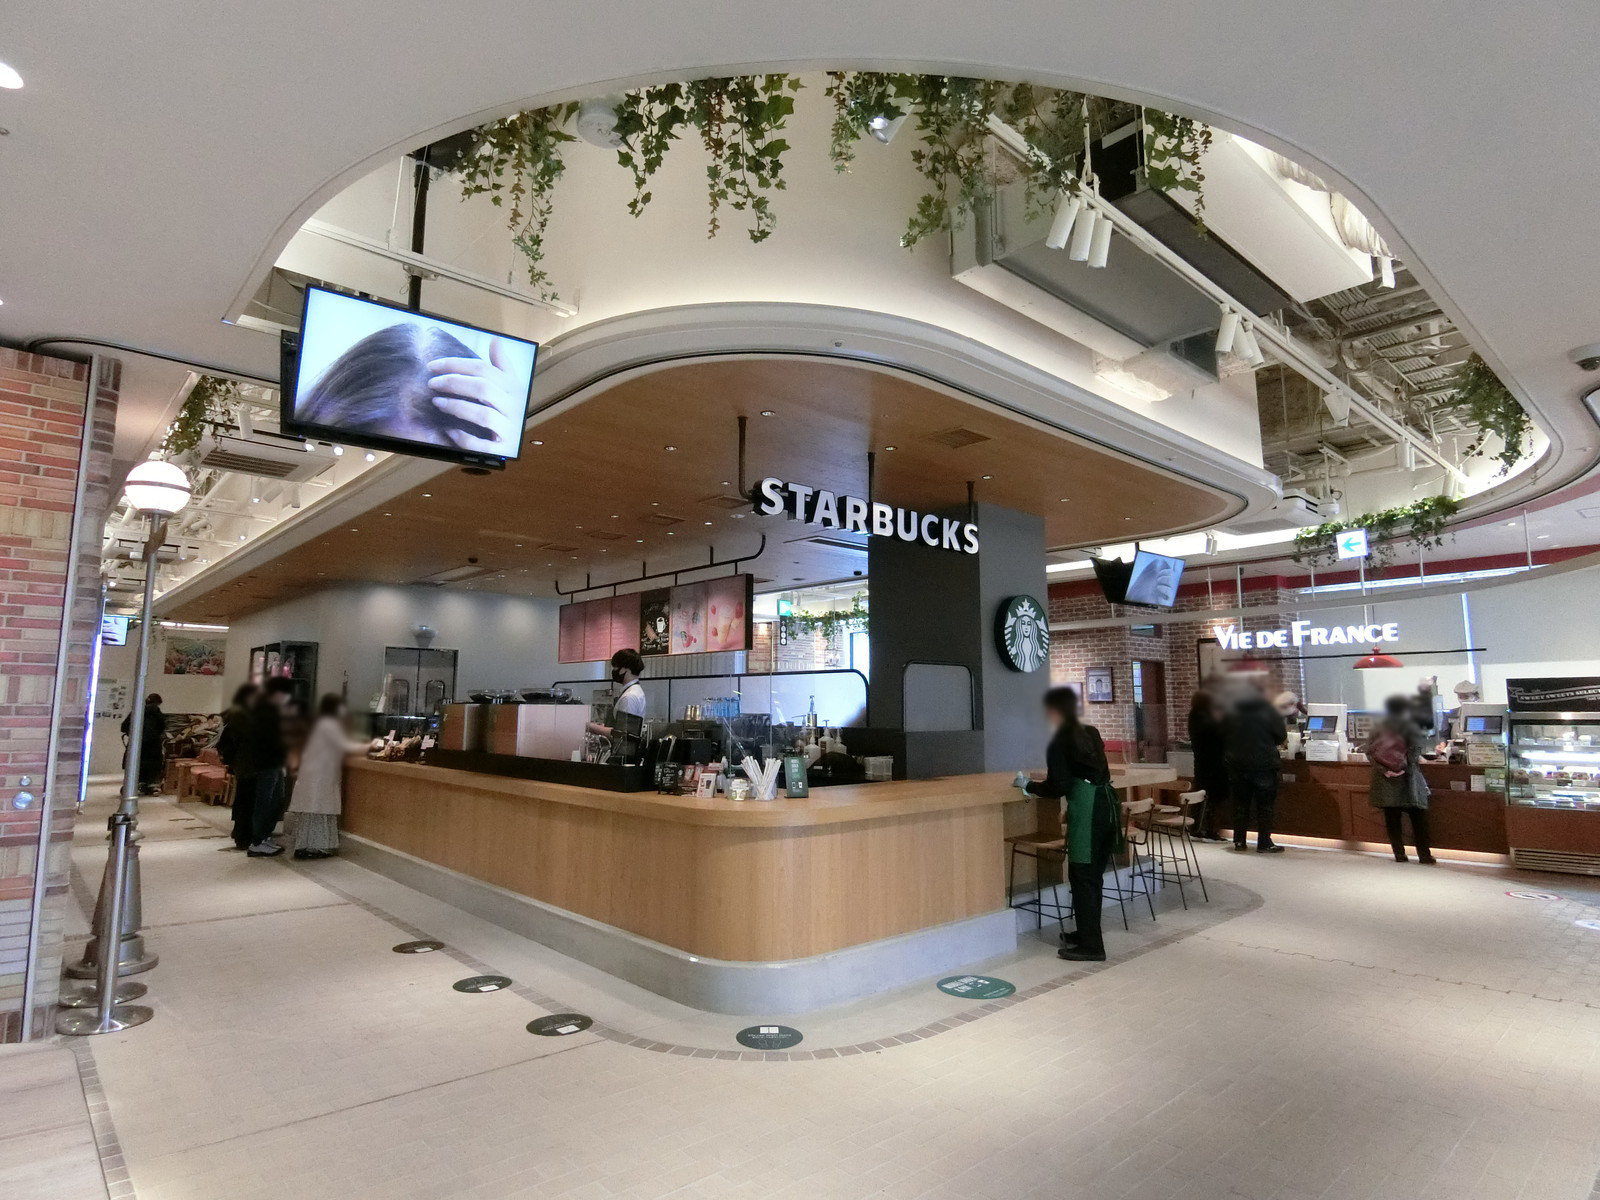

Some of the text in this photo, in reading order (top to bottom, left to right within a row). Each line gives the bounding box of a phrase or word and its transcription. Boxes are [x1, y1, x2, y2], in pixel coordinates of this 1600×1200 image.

[760, 477, 979, 554] STARBUCKS
[1213, 620, 1399, 650] VIE DE FRANCE
